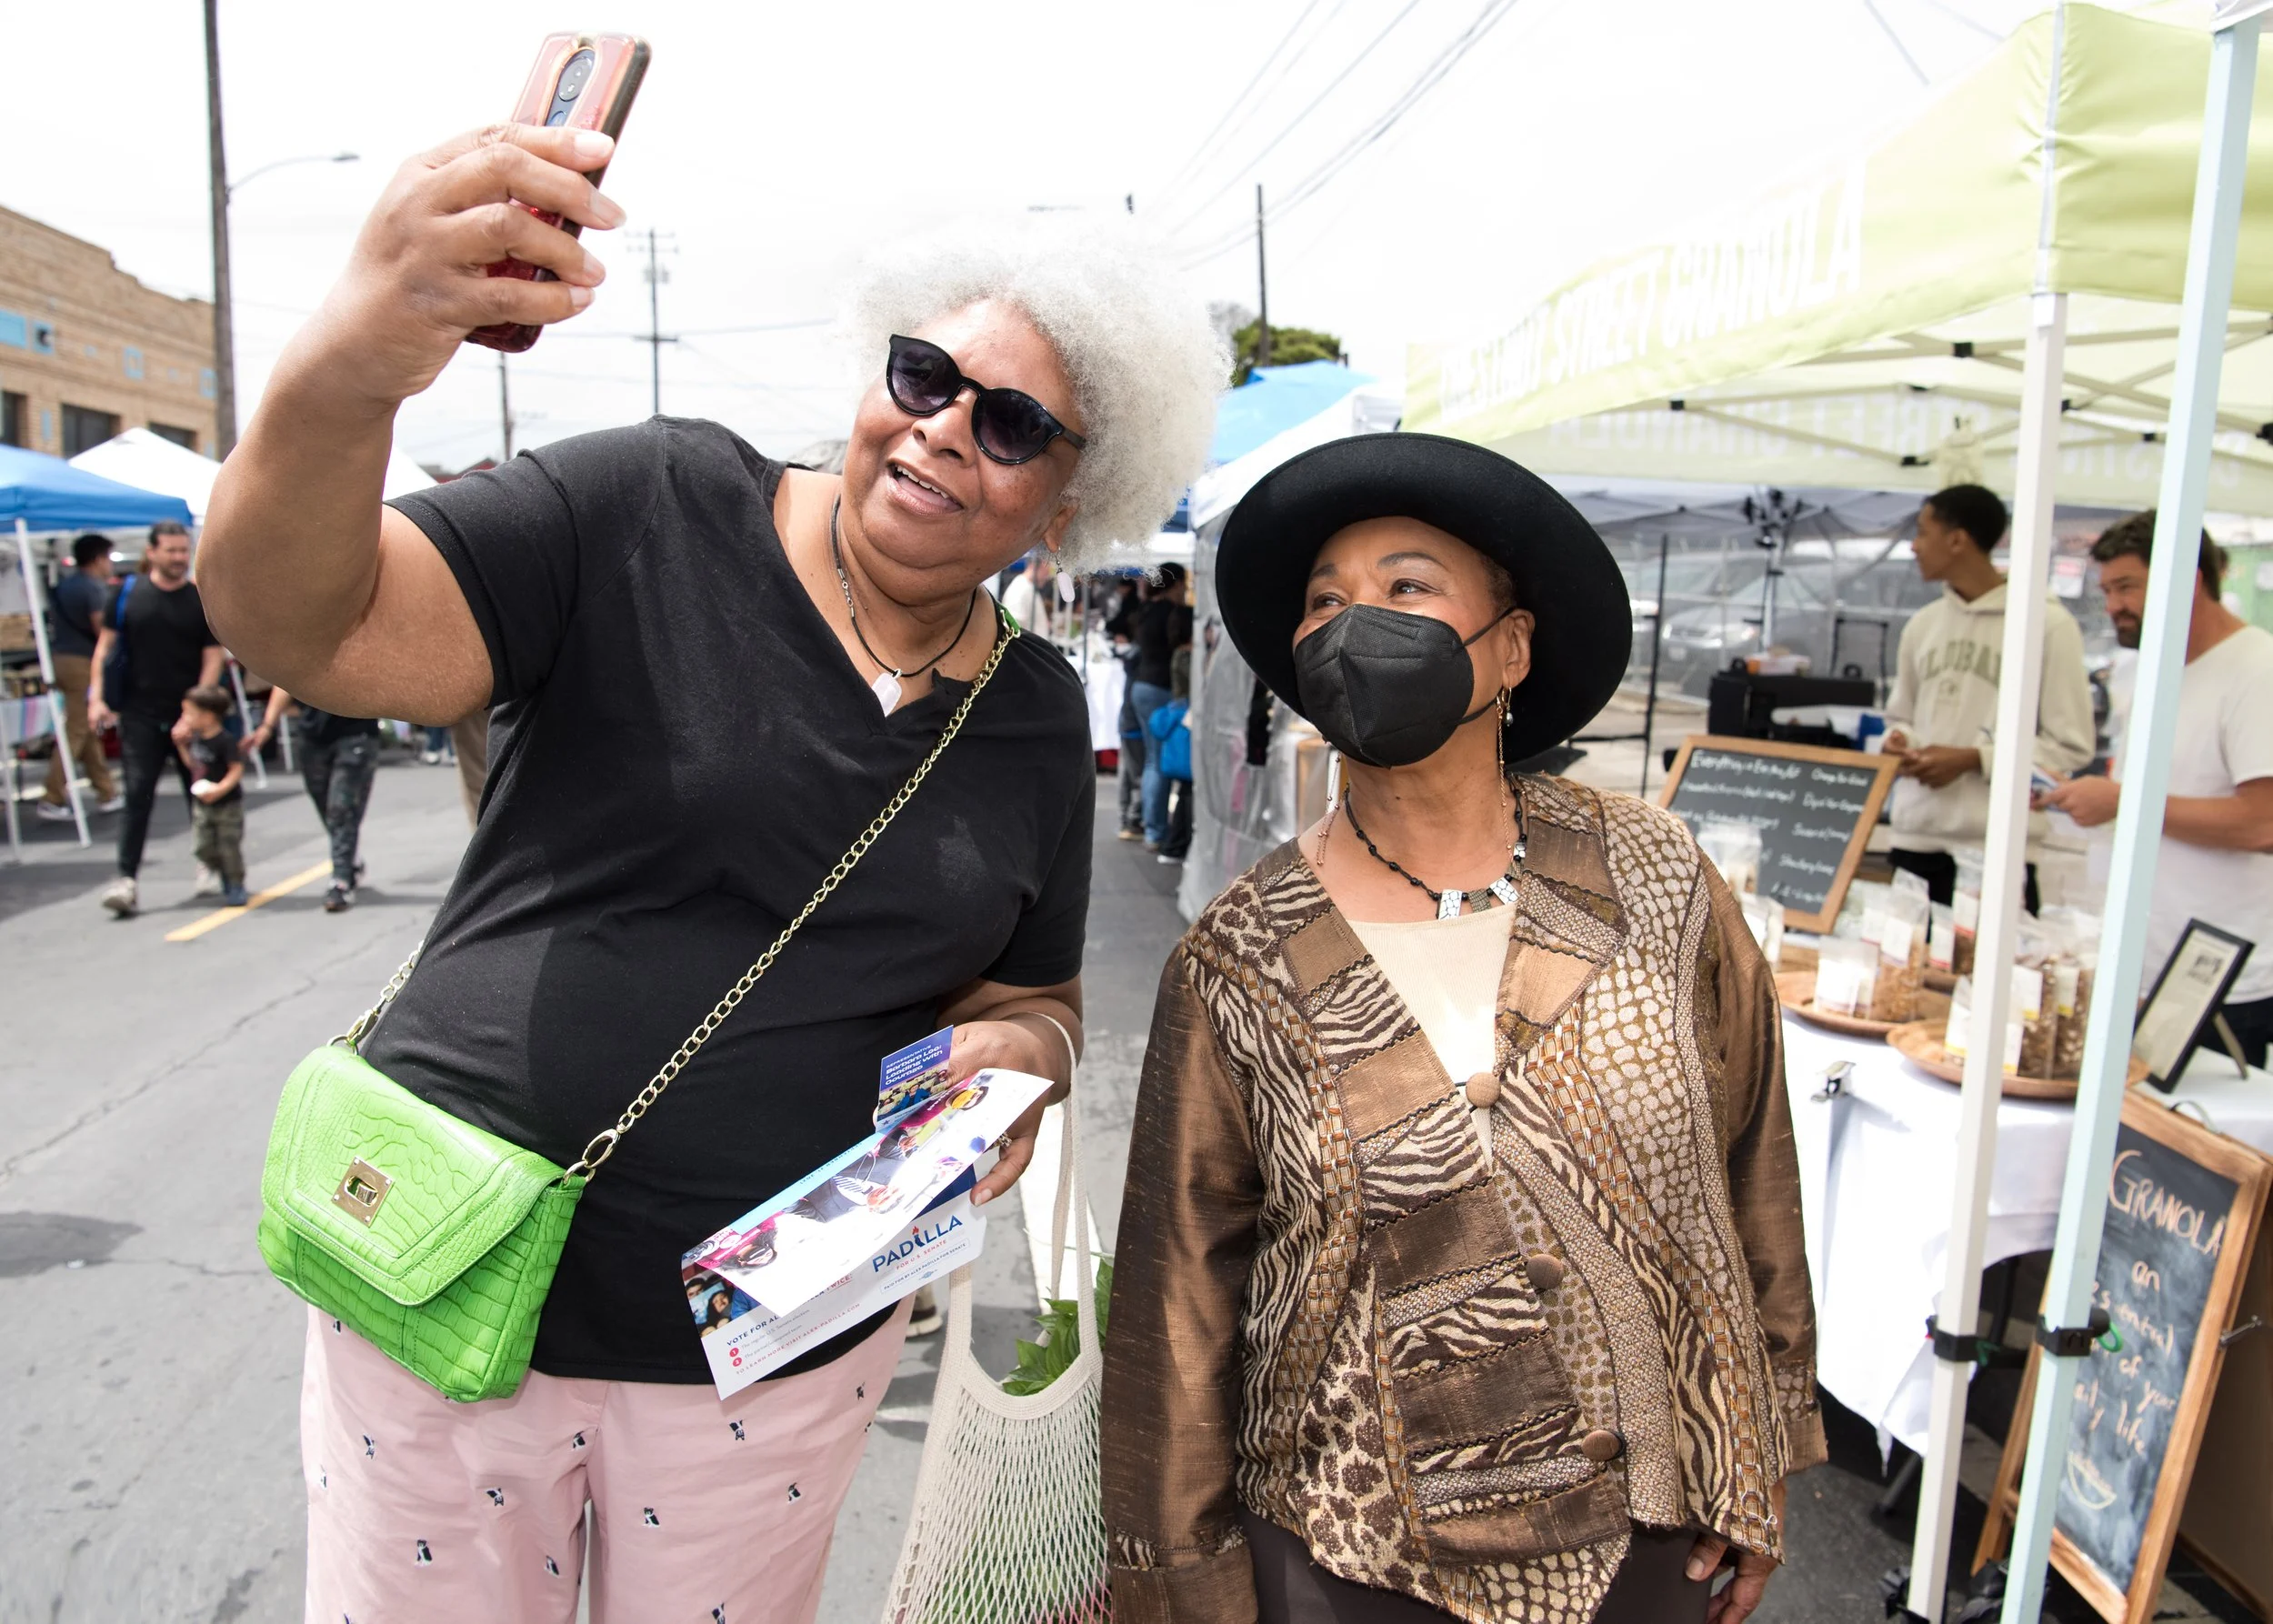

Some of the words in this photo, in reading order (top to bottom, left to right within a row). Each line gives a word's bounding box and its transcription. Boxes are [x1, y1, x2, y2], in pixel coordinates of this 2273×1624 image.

[1549, 250, 1666, 385] STREET
[1661, 156, 1862, 349] GRANOLA
[886, 1045, 932, 1069] REPRESENTATIVE
[886, 1055, 922, 1075] Barbara
[886, 1060, 922, 1080] Leading
[922, 1050, 943, 1063] with
[2108, 1149, 2228, 1259] GRANOLA
[872, 1215, 963, 1273] PADILLA
[896, 1261, 909, 1270] FOR
[924, 1239, 946, 1255] SENATE
[2132, 1260, 2160, 1292] an
[726, 1332, 748, 1347] VOTE
[750, 1321, 767, 1334] FOR
[2116, 1399, 2146, 1455] life
